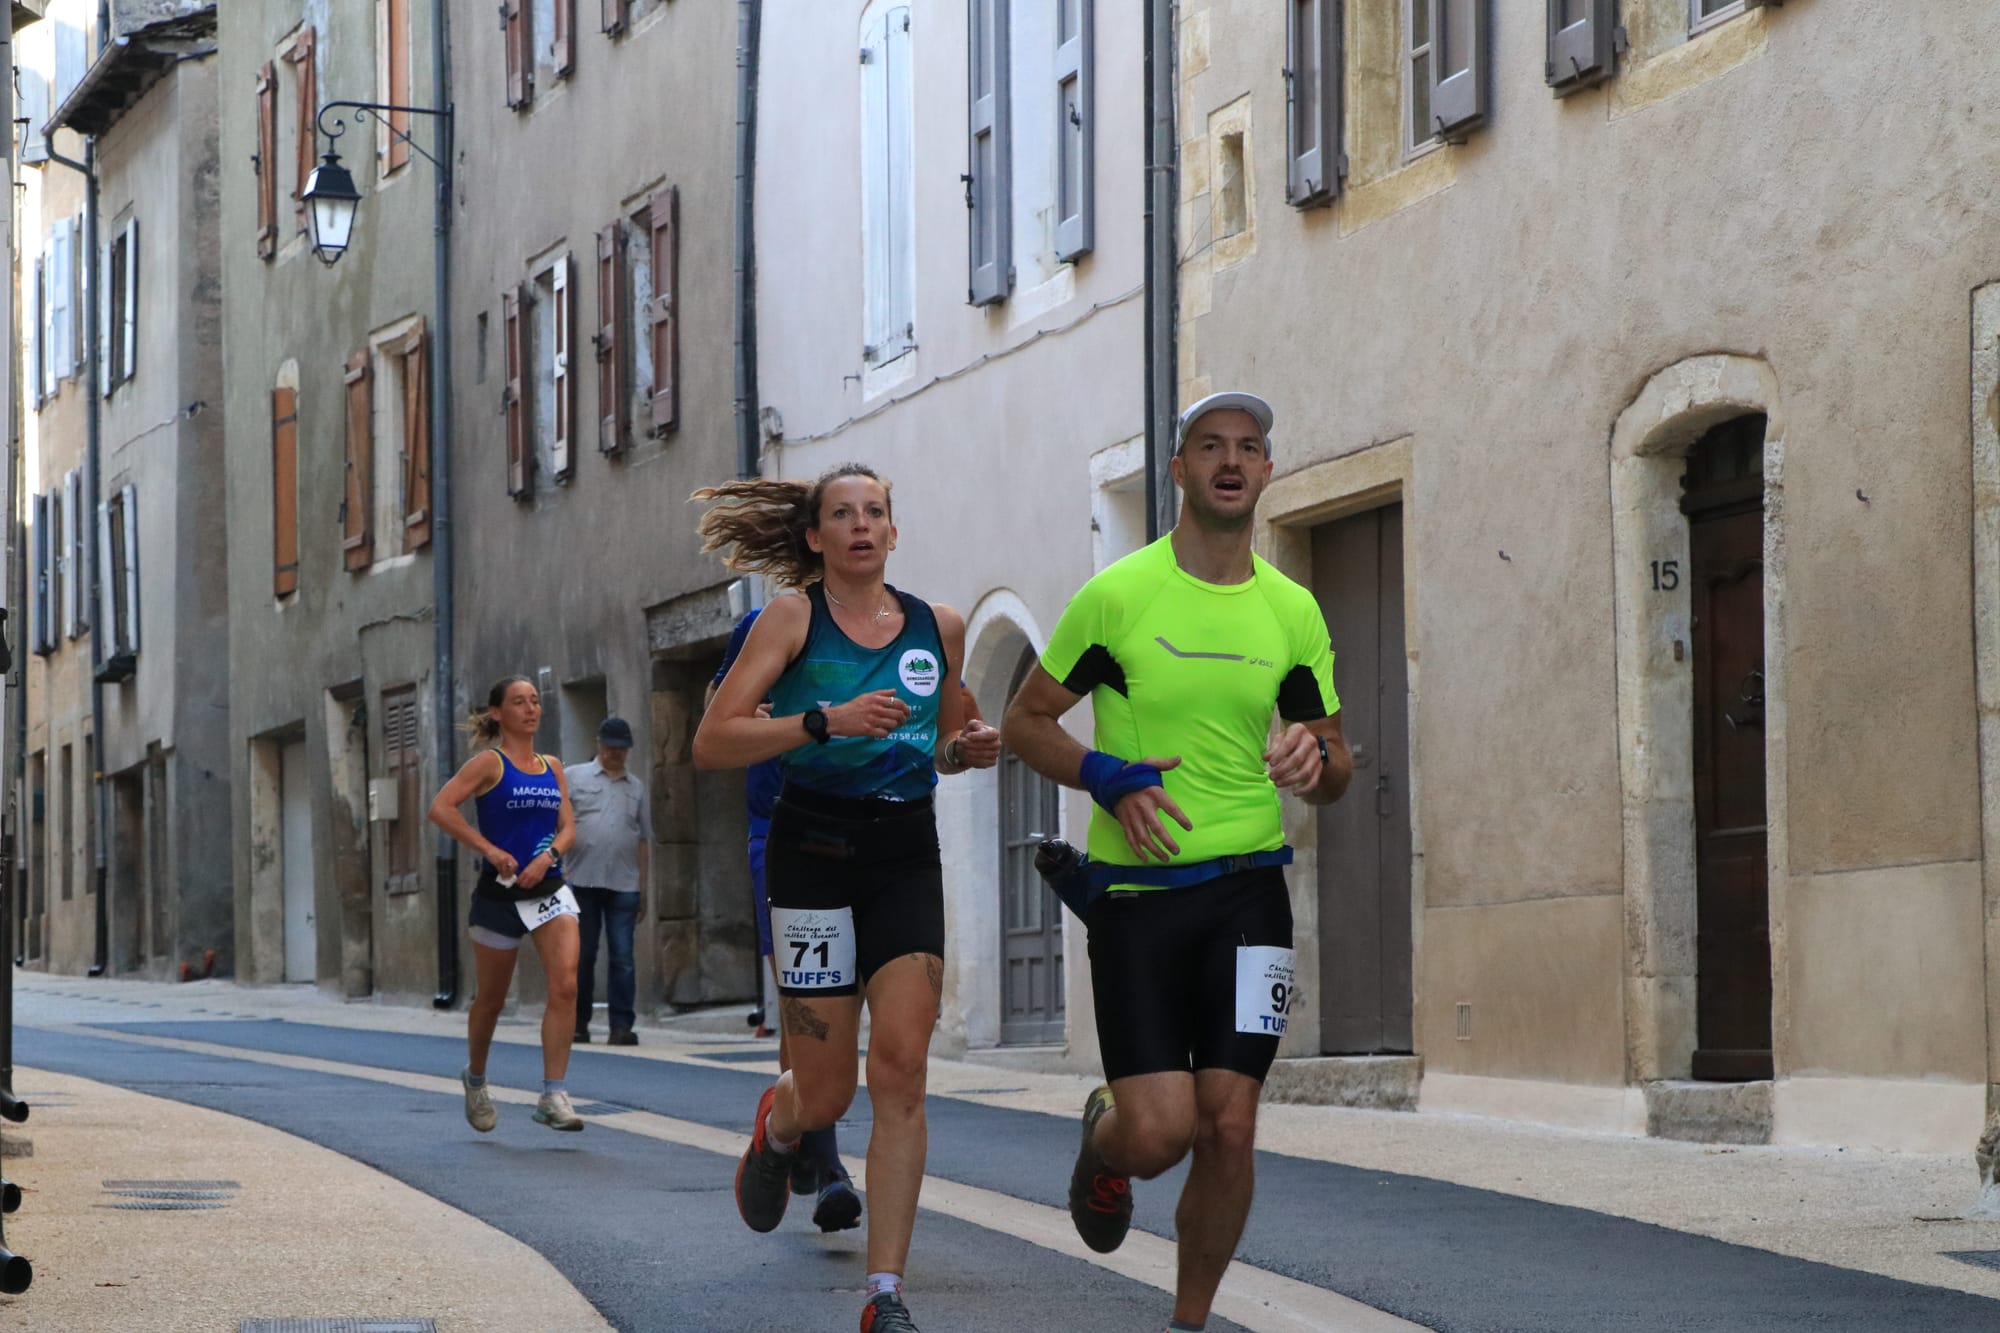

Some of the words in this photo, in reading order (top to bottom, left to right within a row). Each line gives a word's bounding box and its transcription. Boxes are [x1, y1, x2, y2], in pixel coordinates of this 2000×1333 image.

[1651, 560, 1679, 590] 15
[506, 799, 535, 809] CLUB
[538, 895, 561, 914] 44
[790, 941, 828, 968] 71
[782, 970, 842, 985] TUFF'S
[1259, 1015, 1288, 1033] TUF
